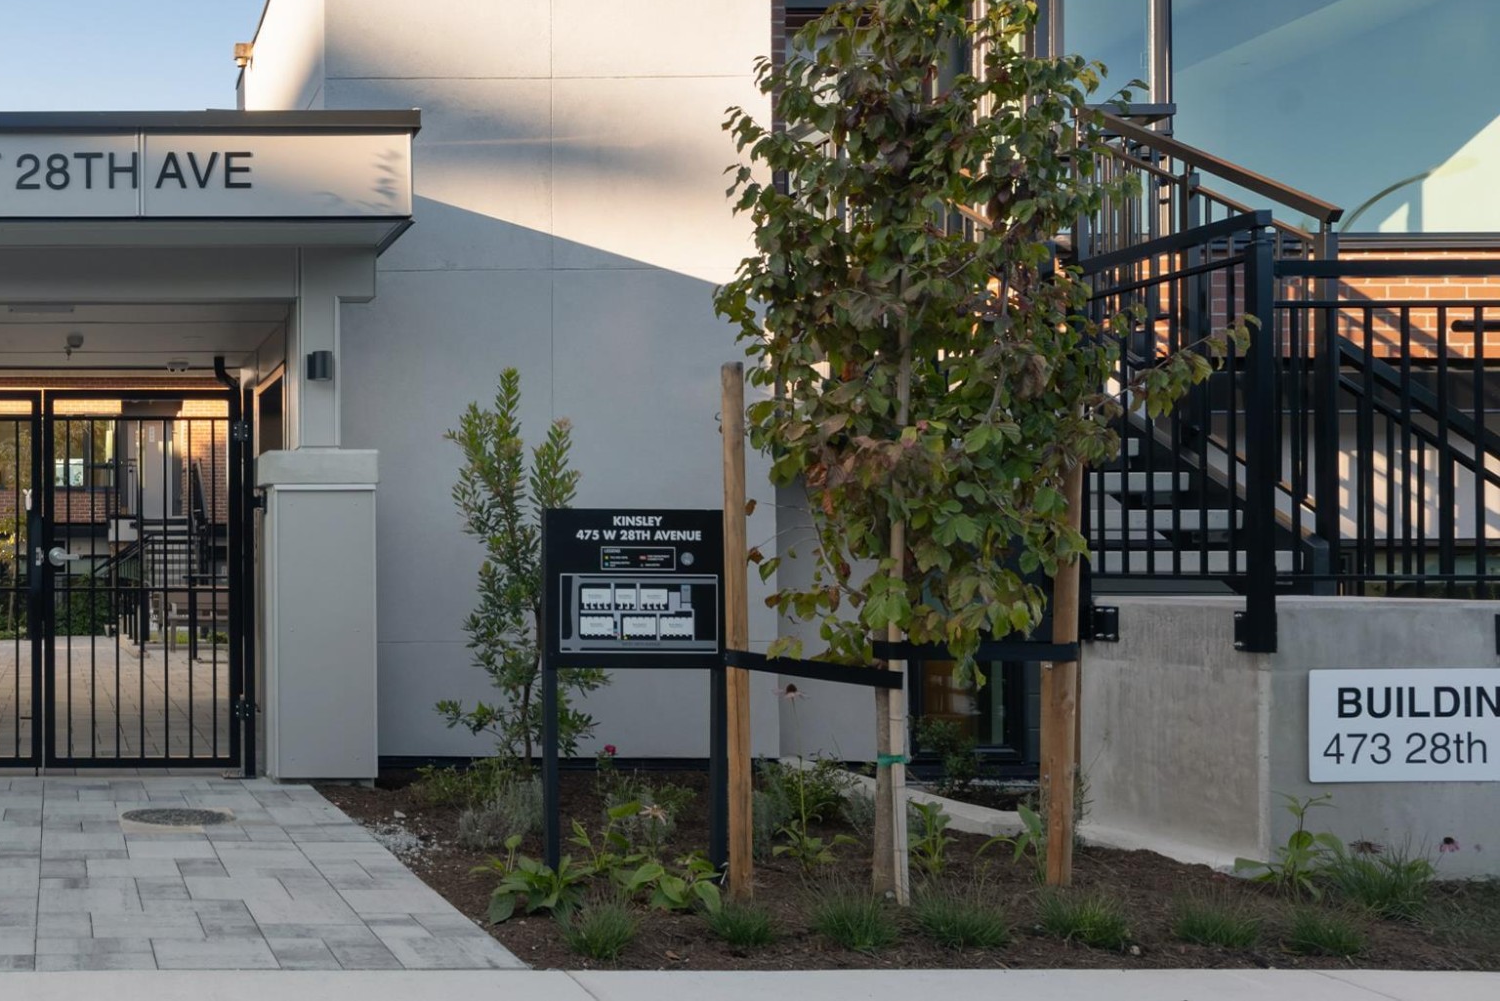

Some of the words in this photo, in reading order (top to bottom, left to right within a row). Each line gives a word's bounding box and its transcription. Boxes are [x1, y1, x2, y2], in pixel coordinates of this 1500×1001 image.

[15, 151, 140, 191] 28TH
[154, 150, 254, 190] AVE
[612, 515, 663, 527] KINSLEY
[575, 529, 600, 541] 475
[602, 529, 617, 541] W
[619, 529, 651, 541] 28TH
[653, 530, 702, 541] AVENUE
[1323, 732, 1392, 765] 473
[1405, 731, 1488, 765] 28th
